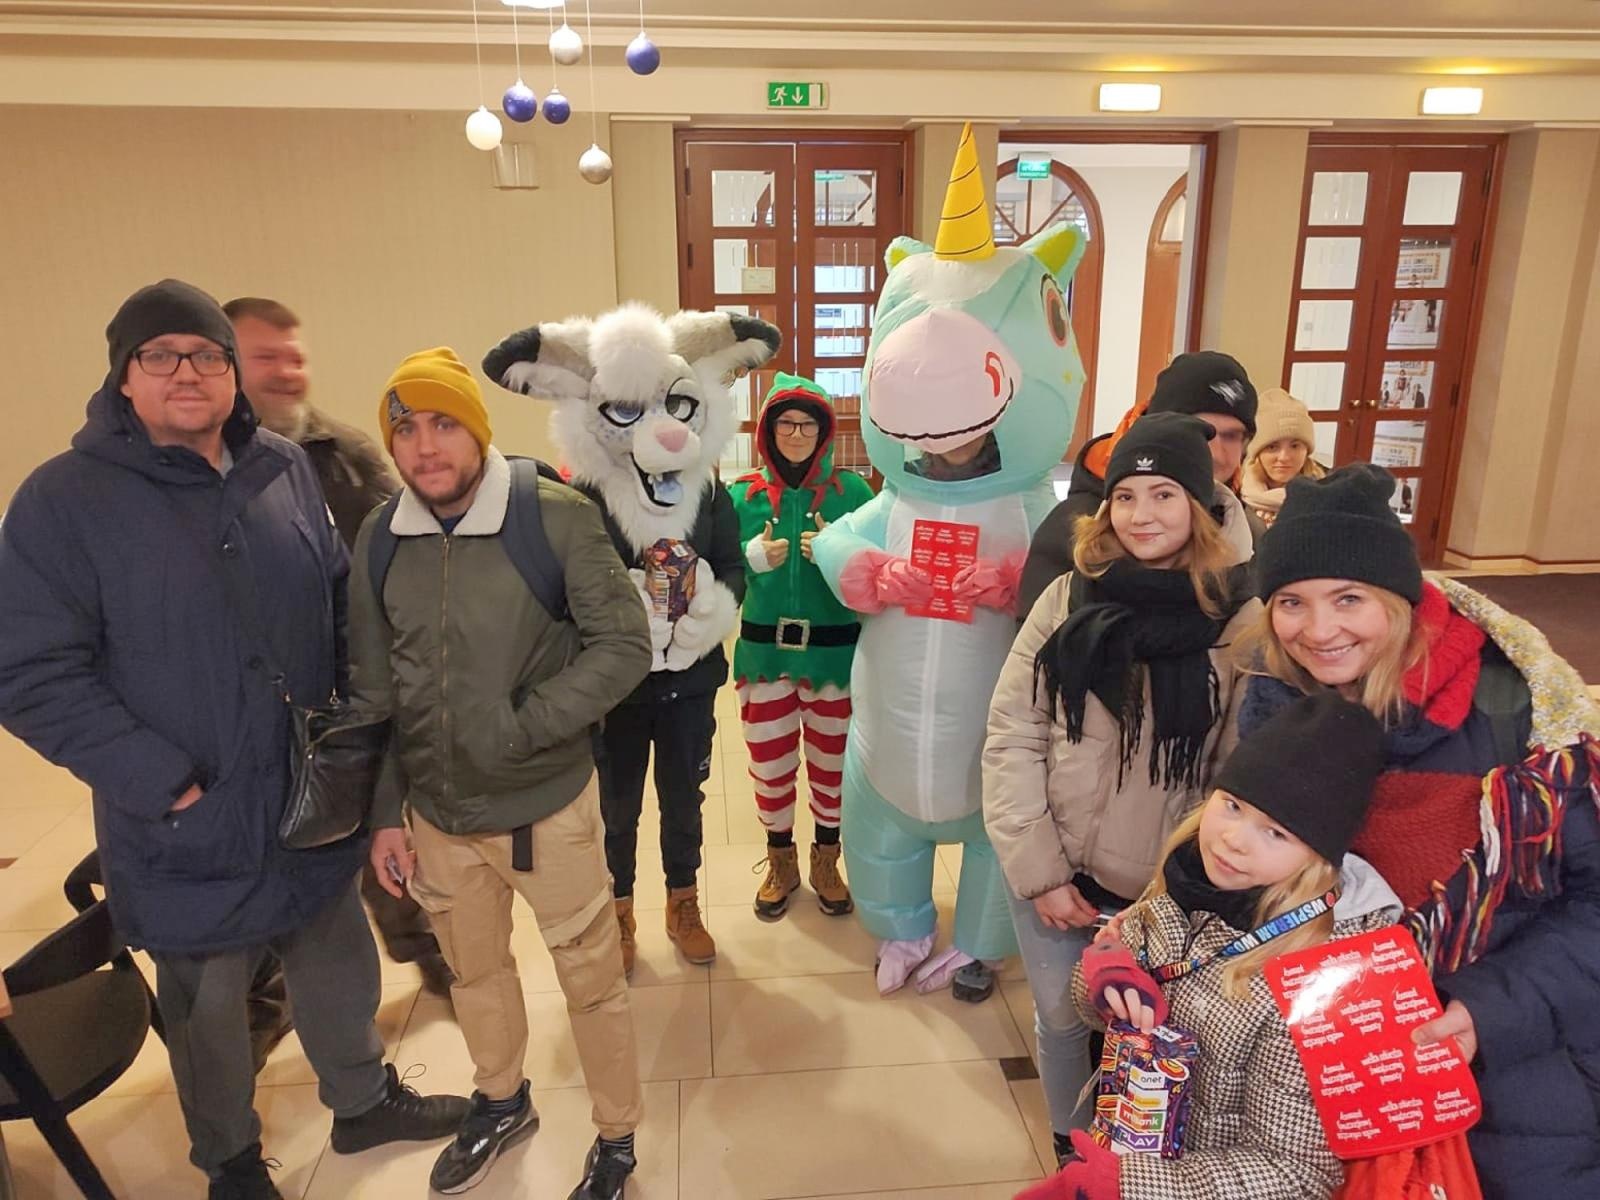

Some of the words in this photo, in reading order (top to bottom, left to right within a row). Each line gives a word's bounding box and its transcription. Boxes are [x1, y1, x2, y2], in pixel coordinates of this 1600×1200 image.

[388, 389, 413, 427] A
[1255, 898, 1328, 942] WSPIERAM
[1123, 1109, 1159, 1126] mank
[1119, 1127, 1156, 1147] PLAY
